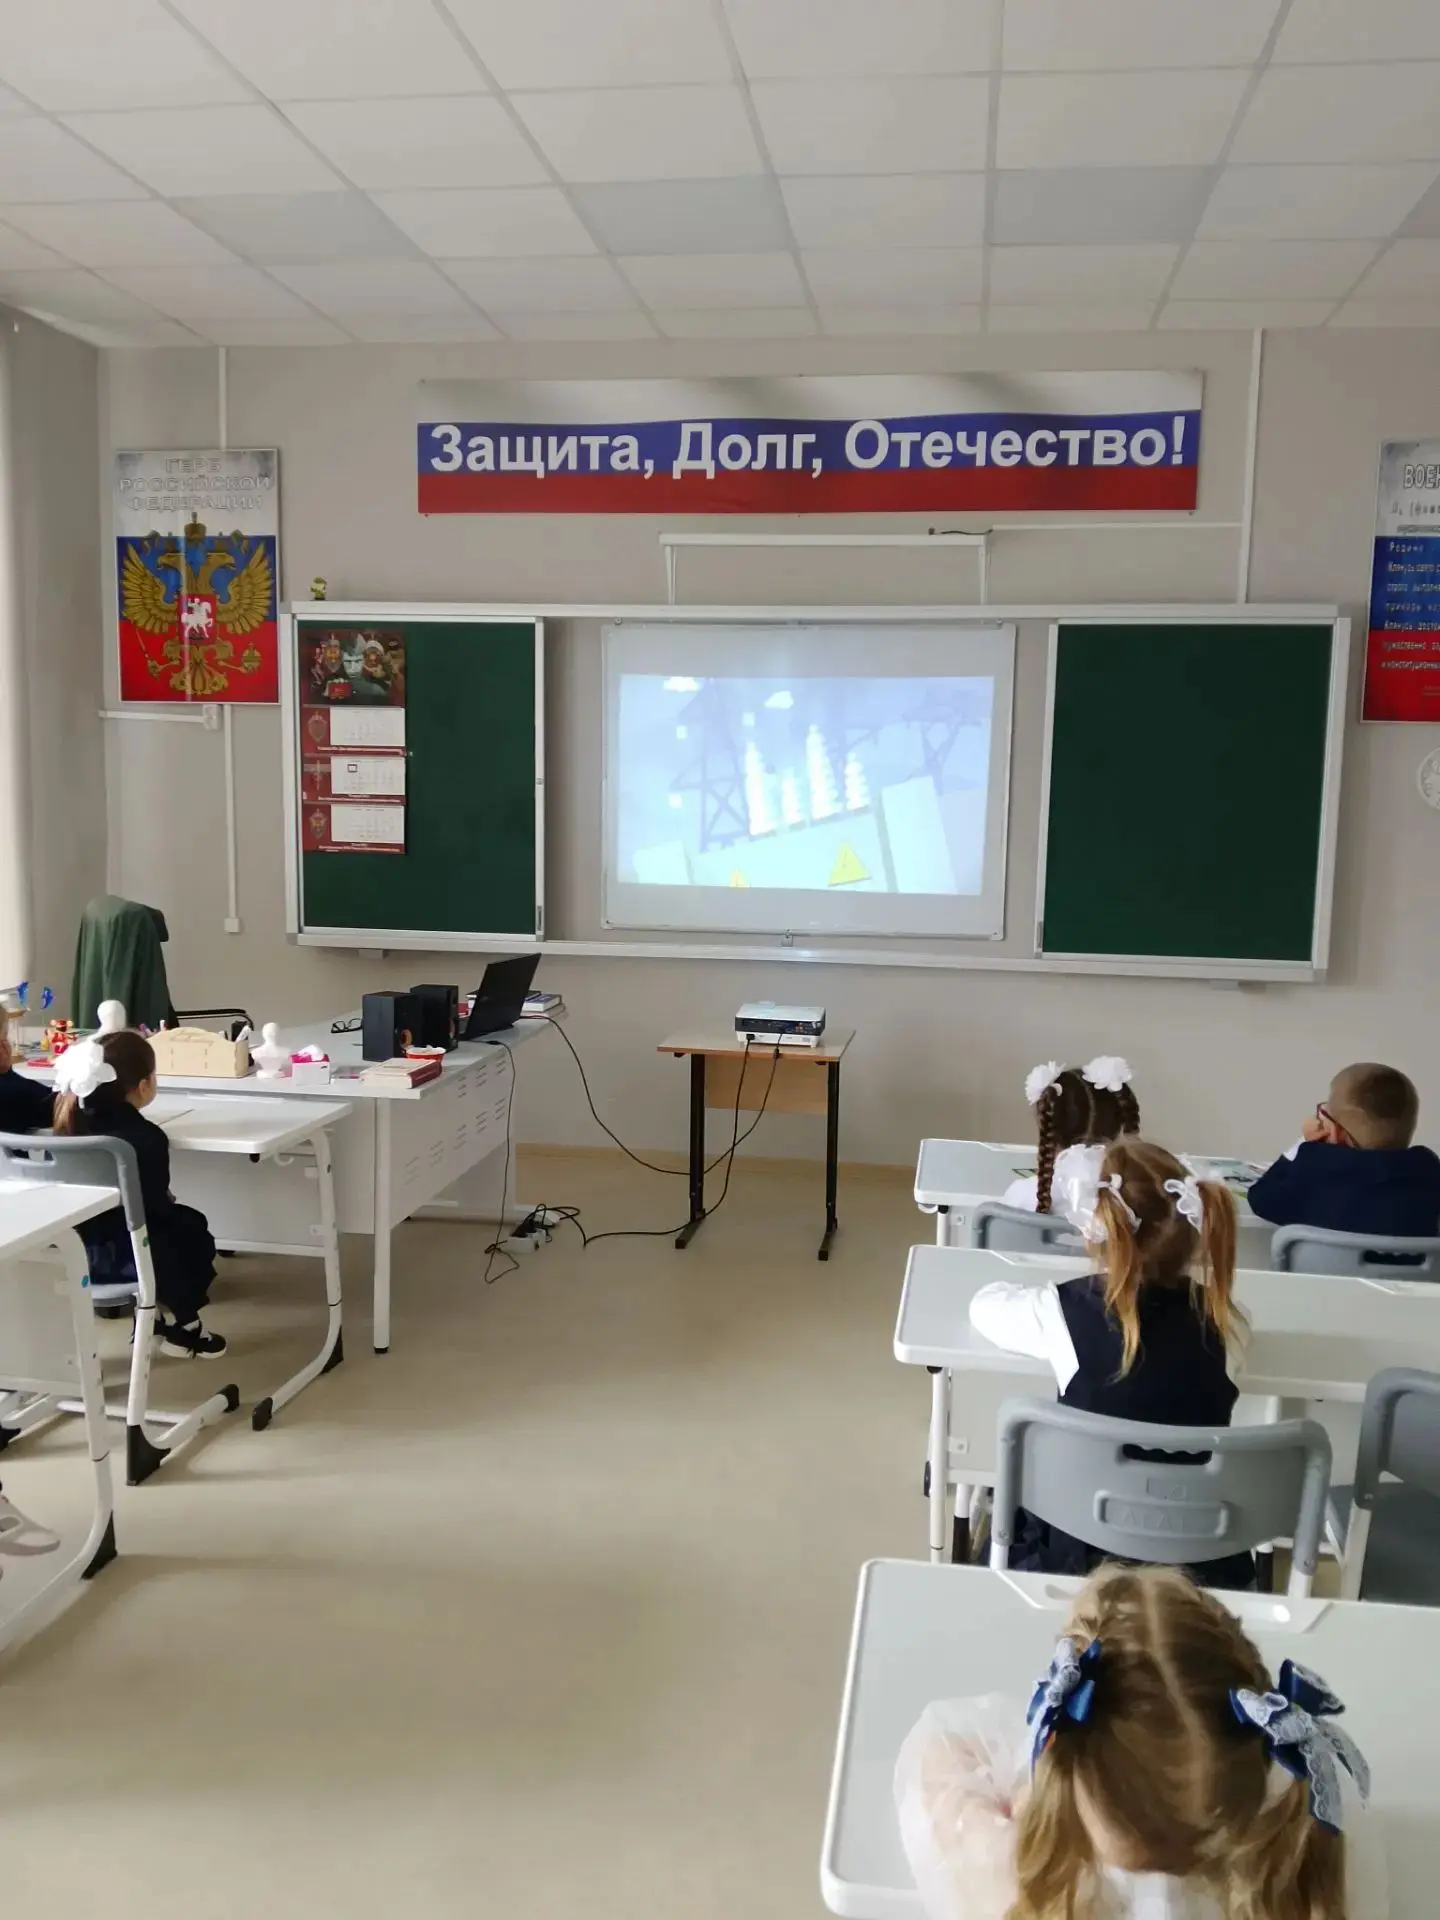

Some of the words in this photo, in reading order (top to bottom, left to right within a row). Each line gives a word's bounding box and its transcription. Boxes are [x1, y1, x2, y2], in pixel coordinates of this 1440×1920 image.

[430, 424, 655, 479] Защита,
[672, 422, 823, 479] Долг,
[844, 415, 1186, 469] Отечество!
[165, 457, 222, 473] ГЕРБ
[119, 473, 272, 492] РОССИЙСКОЙ
[128, 495, 263, 513] ФЕДЕРАЦИИ
